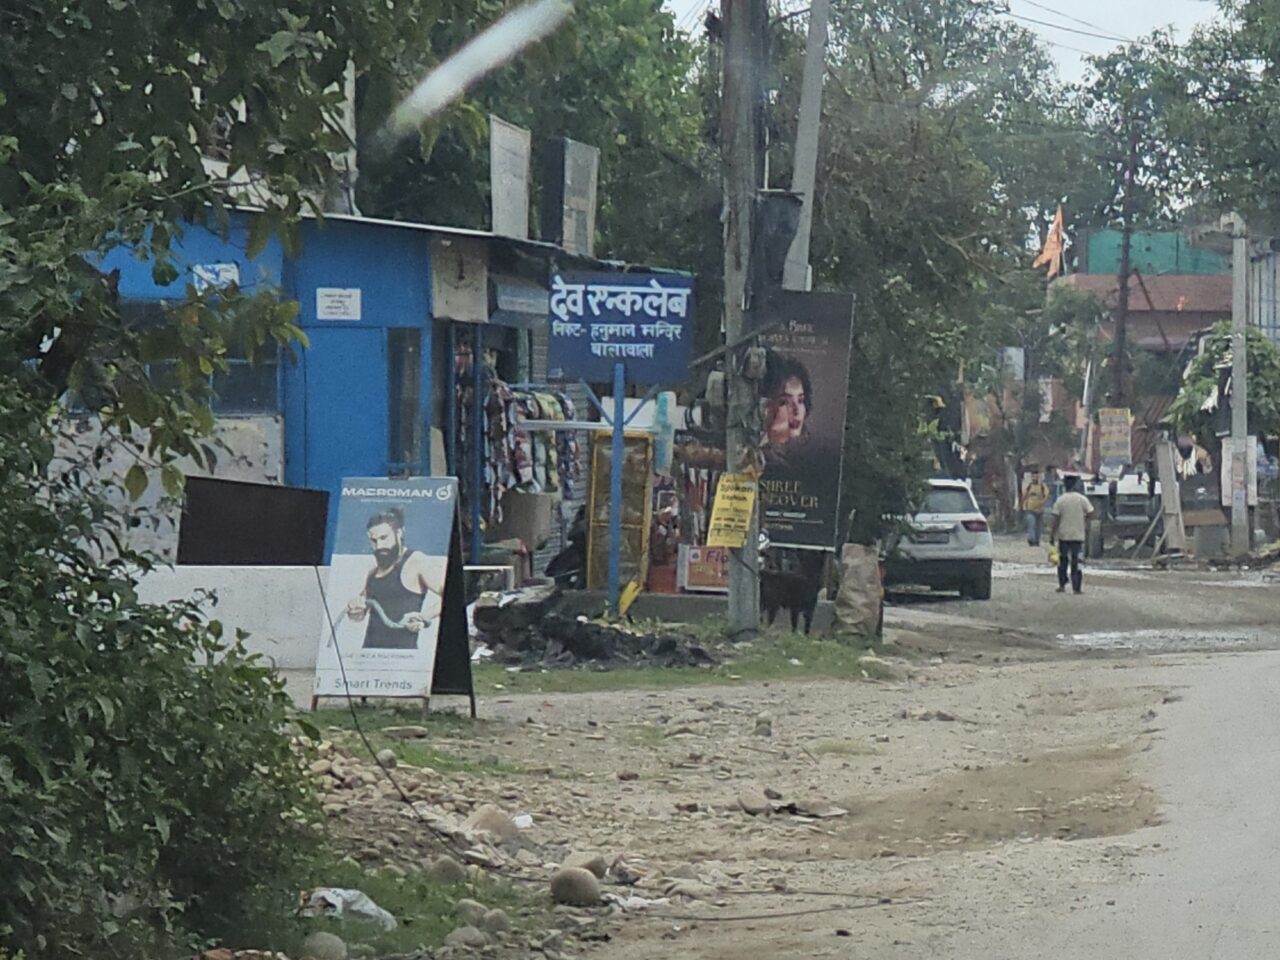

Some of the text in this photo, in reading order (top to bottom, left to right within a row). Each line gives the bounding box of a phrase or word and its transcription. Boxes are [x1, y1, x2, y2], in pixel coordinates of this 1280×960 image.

[551, 275, 585, 321] देव
[590, 322, 635, 341] हनुमान
[342, 487, 433, 497] MACROMAN
[374, 679, 412, 689] Trends
